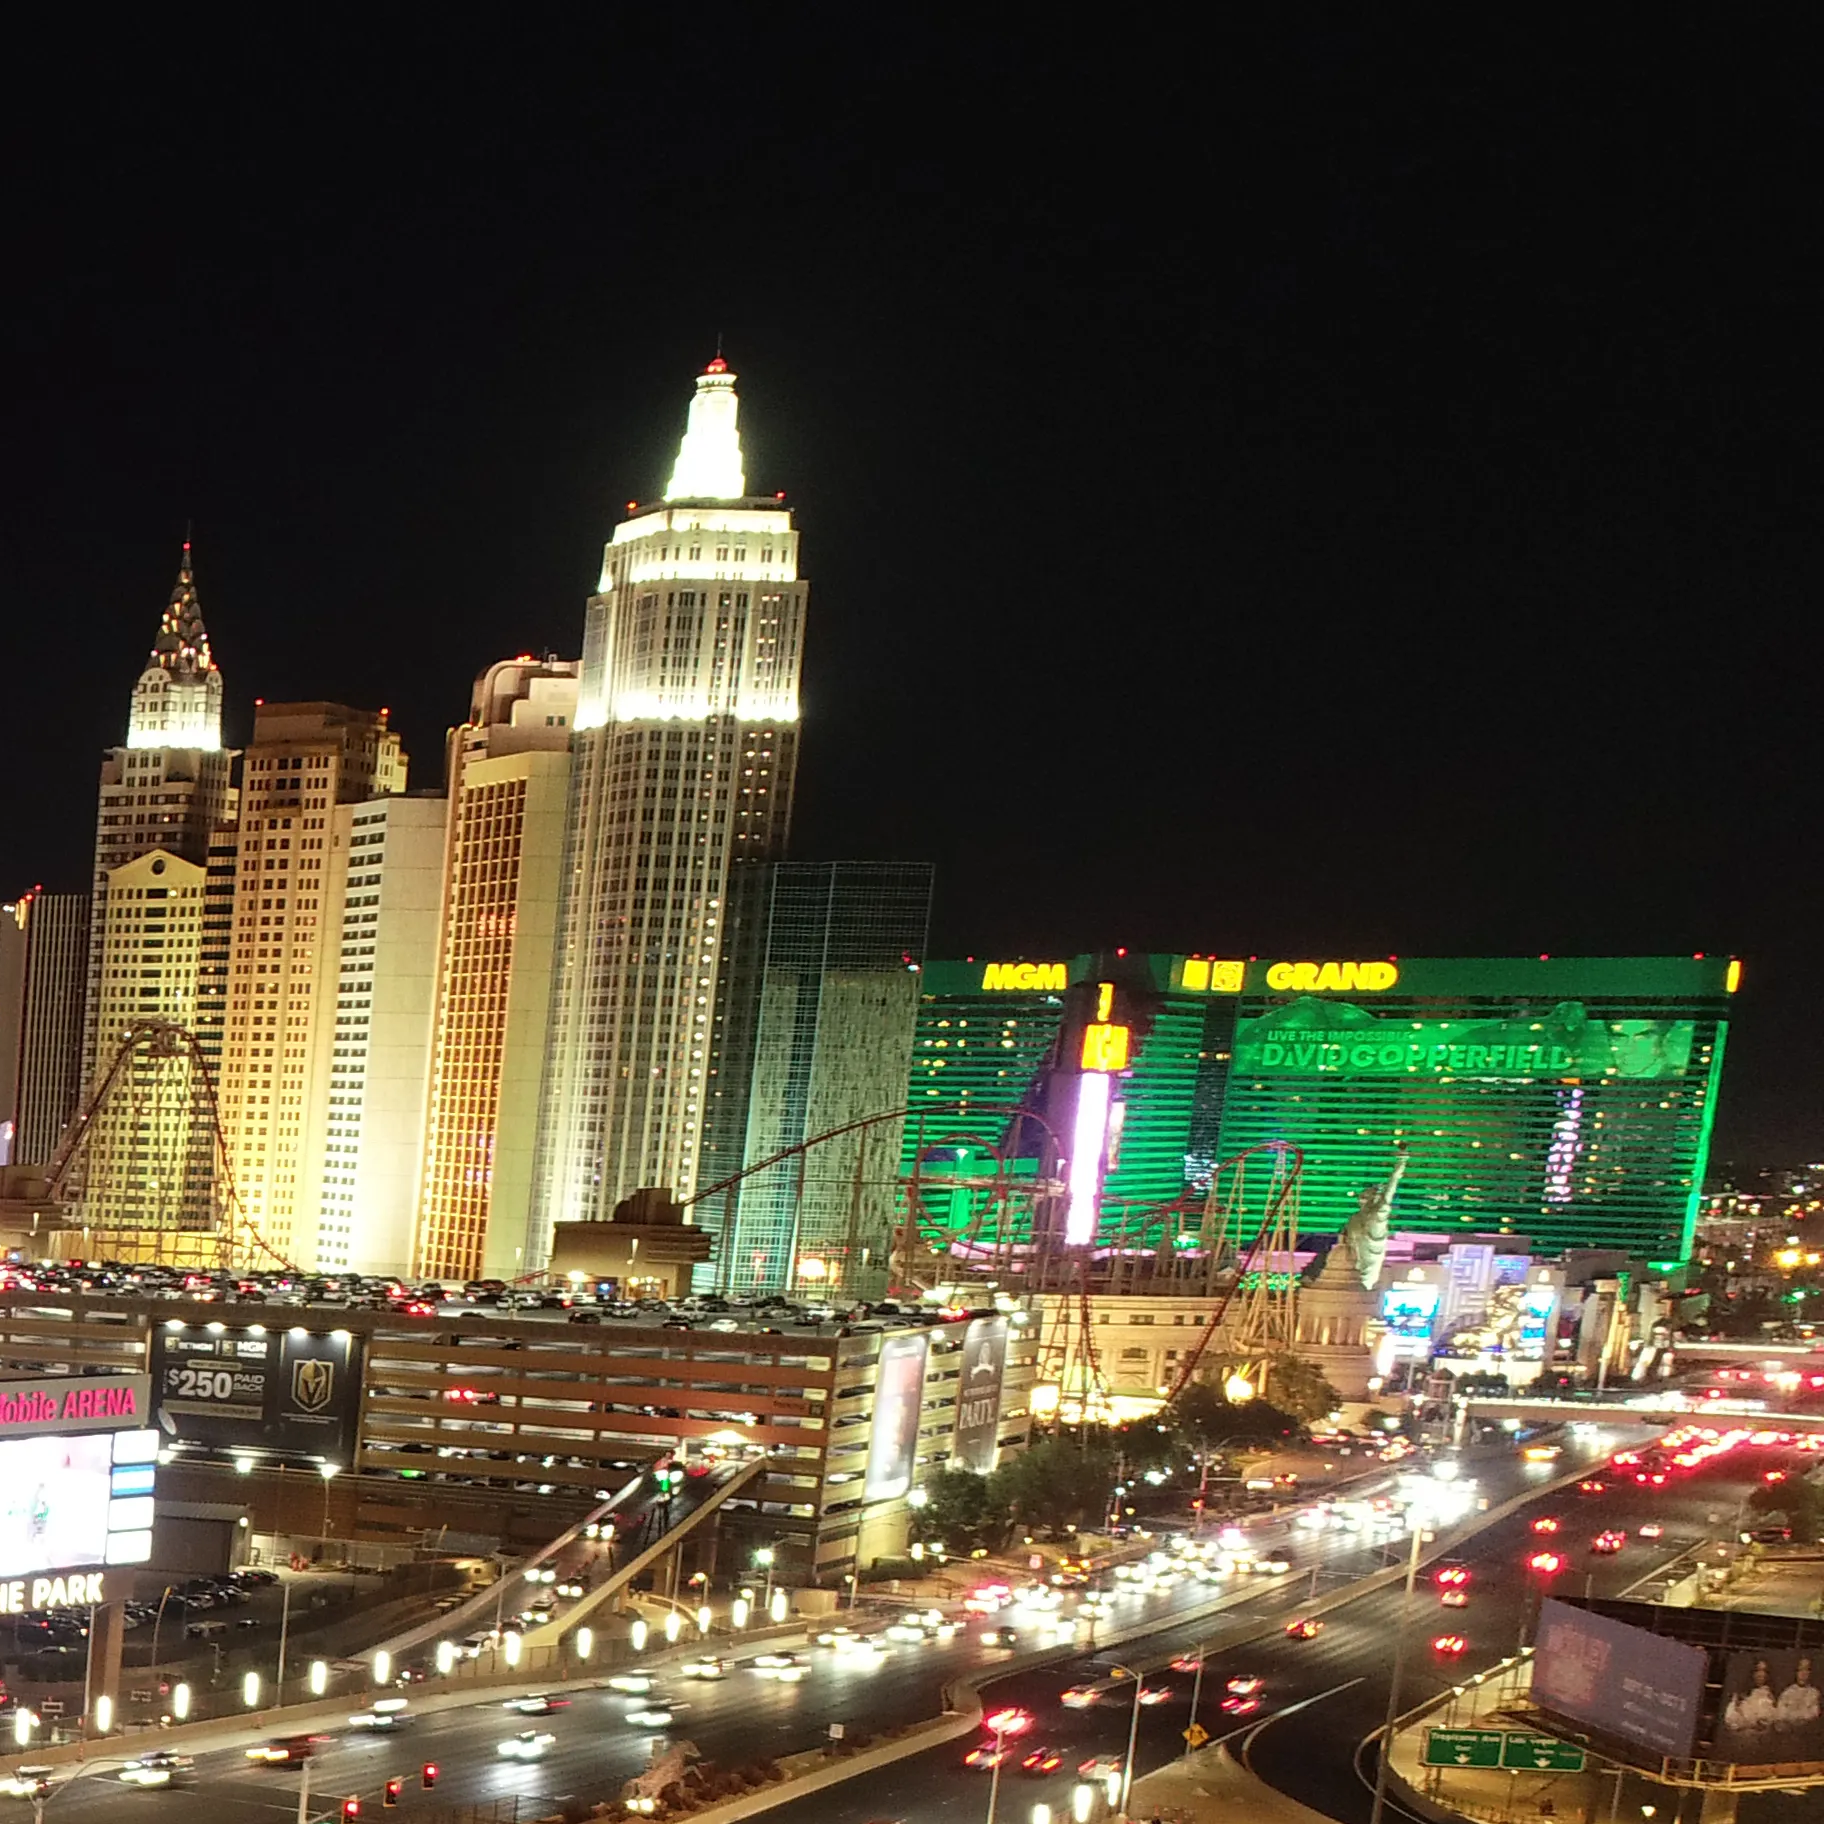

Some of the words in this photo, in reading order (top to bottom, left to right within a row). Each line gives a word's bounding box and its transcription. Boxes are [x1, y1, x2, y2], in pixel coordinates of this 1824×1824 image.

[981, 963, 1068, 990] MGM
[1266, 962, 1399, 991] GRAND
[1267, 1030, 1296, 1041] LIVE
[1299, 1031, 1325, 1041] THE
[167, 1367, 232, 1399] $250
[232, 1373, 266, 1385] PAID
[62, 1388, 137, 1420] ARENA
[31, 1572, 104, 1609] PARK
